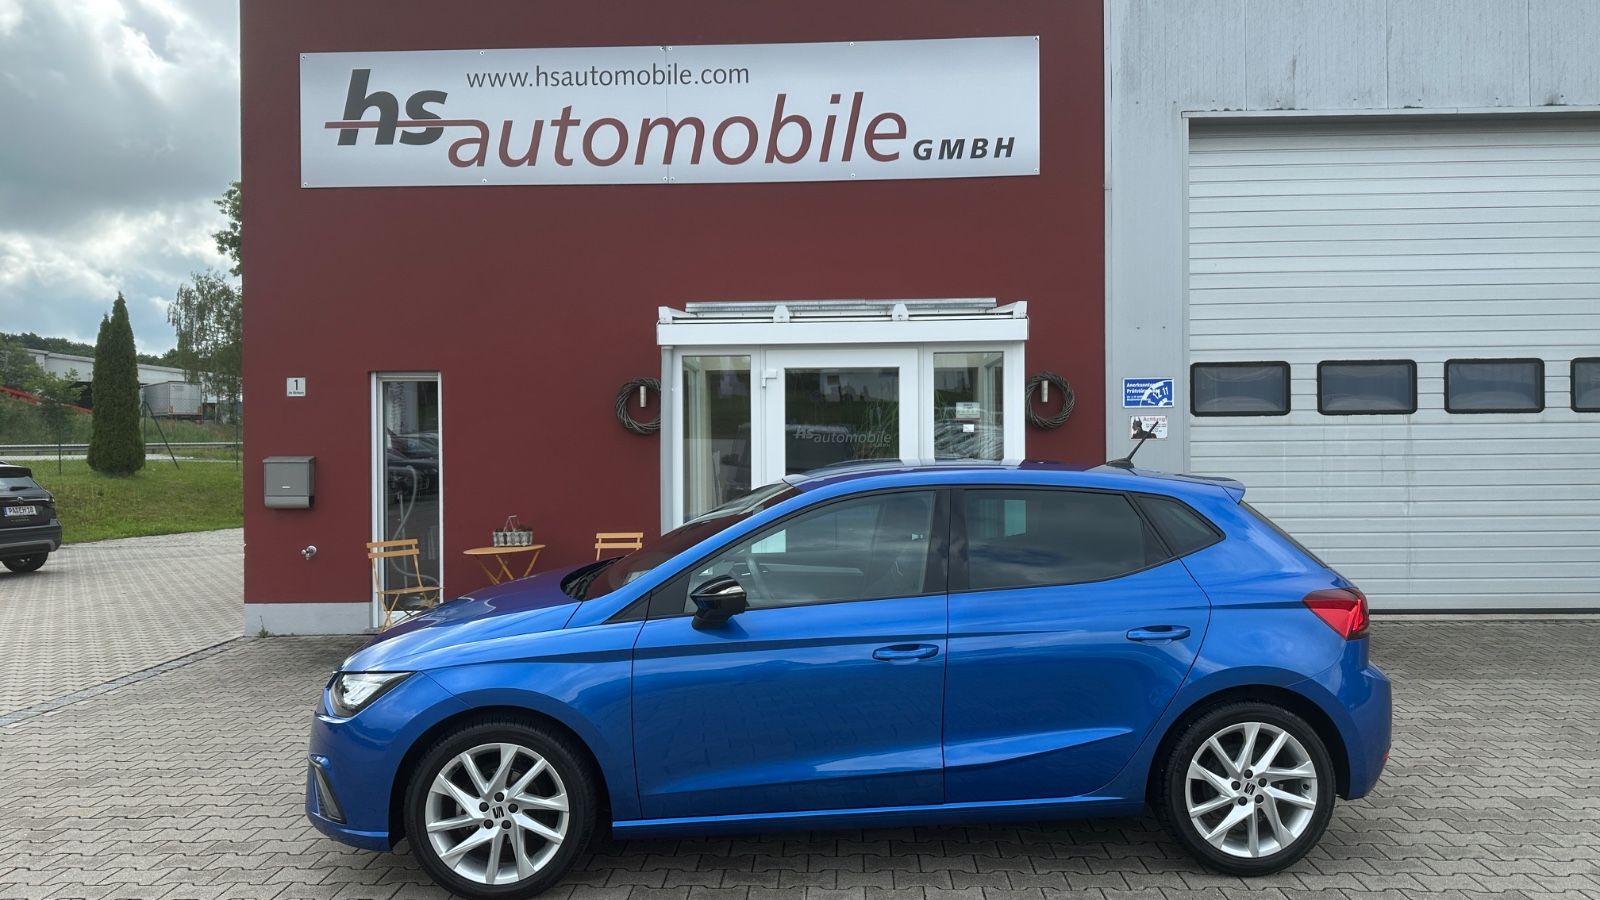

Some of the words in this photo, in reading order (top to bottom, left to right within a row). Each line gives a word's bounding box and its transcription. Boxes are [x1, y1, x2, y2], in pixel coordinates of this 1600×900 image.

[466, 62, 750, 88] www.hsautomobile.com
[447, 91, 907, 168] automobile
[913, 136, 1016, 161] GMBH
[294, 379, 298, 391] 1
